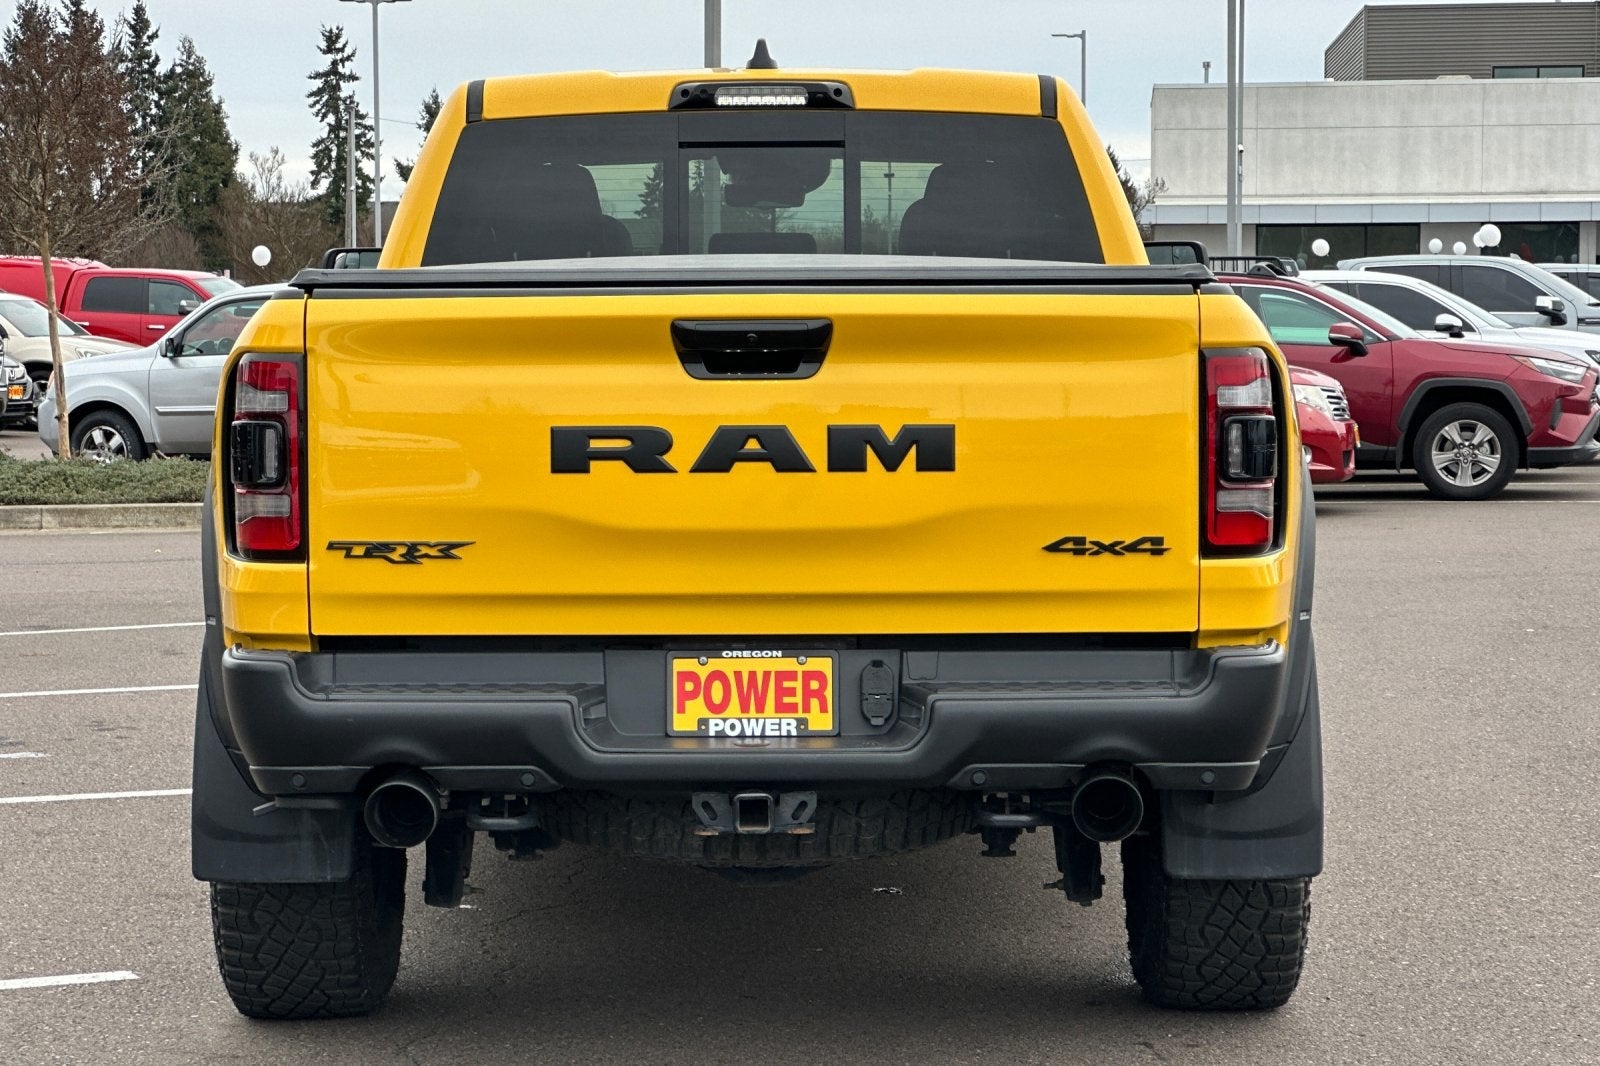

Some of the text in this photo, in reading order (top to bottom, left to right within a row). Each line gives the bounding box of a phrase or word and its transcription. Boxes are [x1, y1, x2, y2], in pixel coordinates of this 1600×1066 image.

[550, 424, 956, 474] RAM
[326, 541, 476, 565] TRX
[1041, 536, 1172, 556] 4x4
[721, 650, 783, 658] OREGON
[676, 669, 829, 715] POWER
[708, 718, 798, 737] POWER
